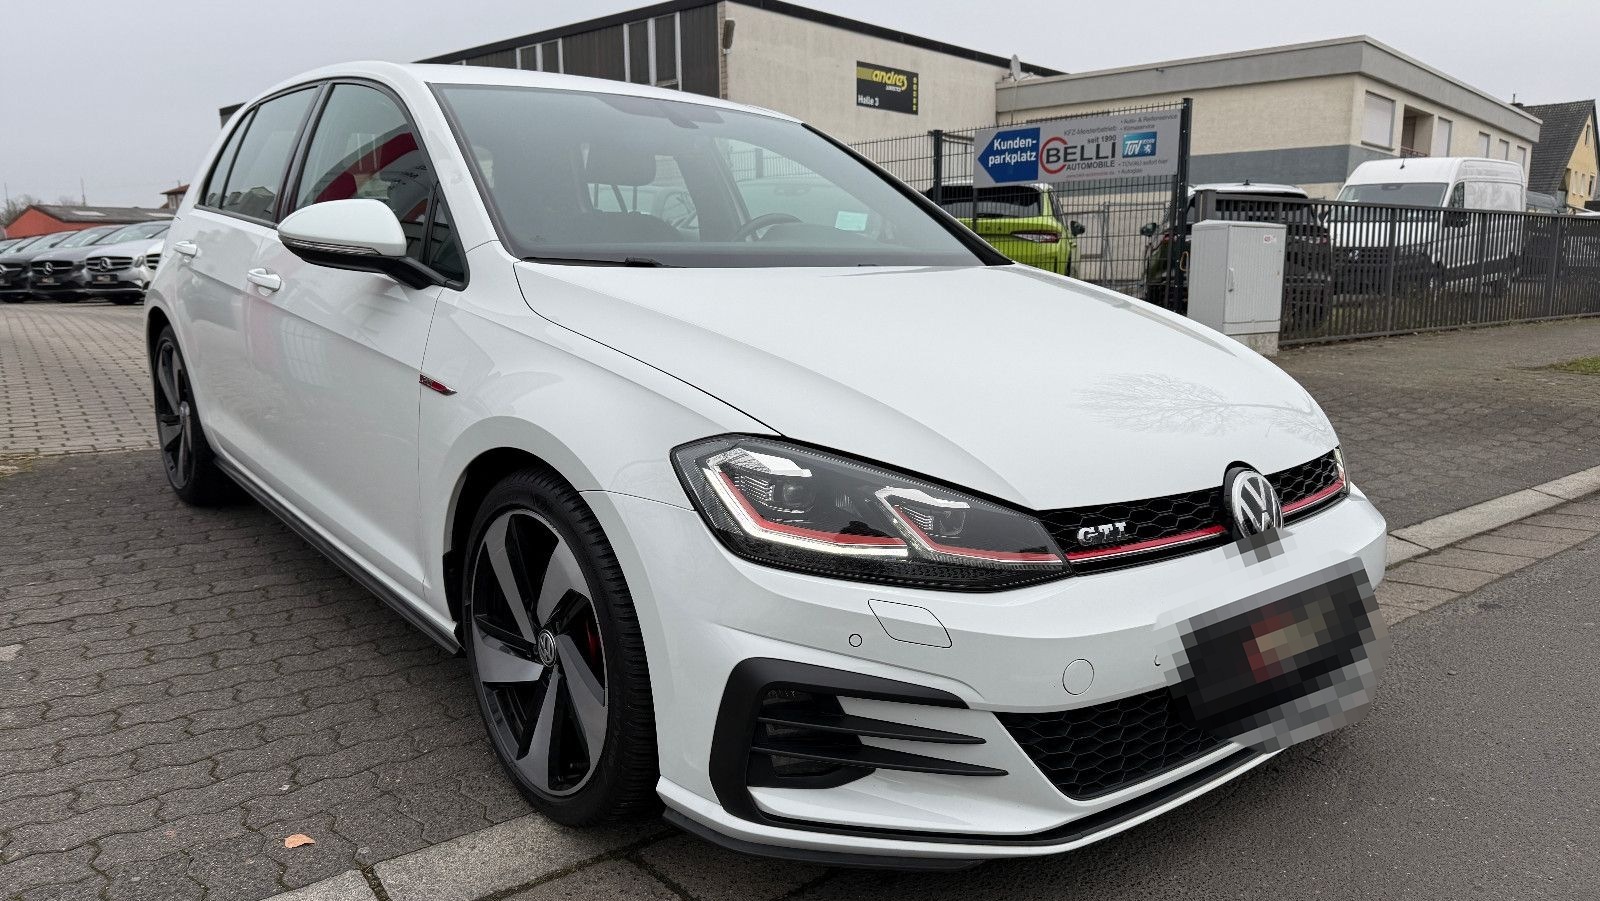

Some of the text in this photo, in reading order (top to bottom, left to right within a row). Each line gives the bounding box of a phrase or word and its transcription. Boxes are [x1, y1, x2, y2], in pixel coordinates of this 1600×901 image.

[858, 94, 880, 107] Halle 3
[993, 137, 1038, 151] Kunden-
[1087, 134, 1117, 145] seit 1990
[988, 151, 1037, 168] parkplatz
[1045, 142, 1117, 164] BELLI
[1066, 160, 1116, 171] AUTOMOBILE
[1077, 521, 1127, 546] GTI
